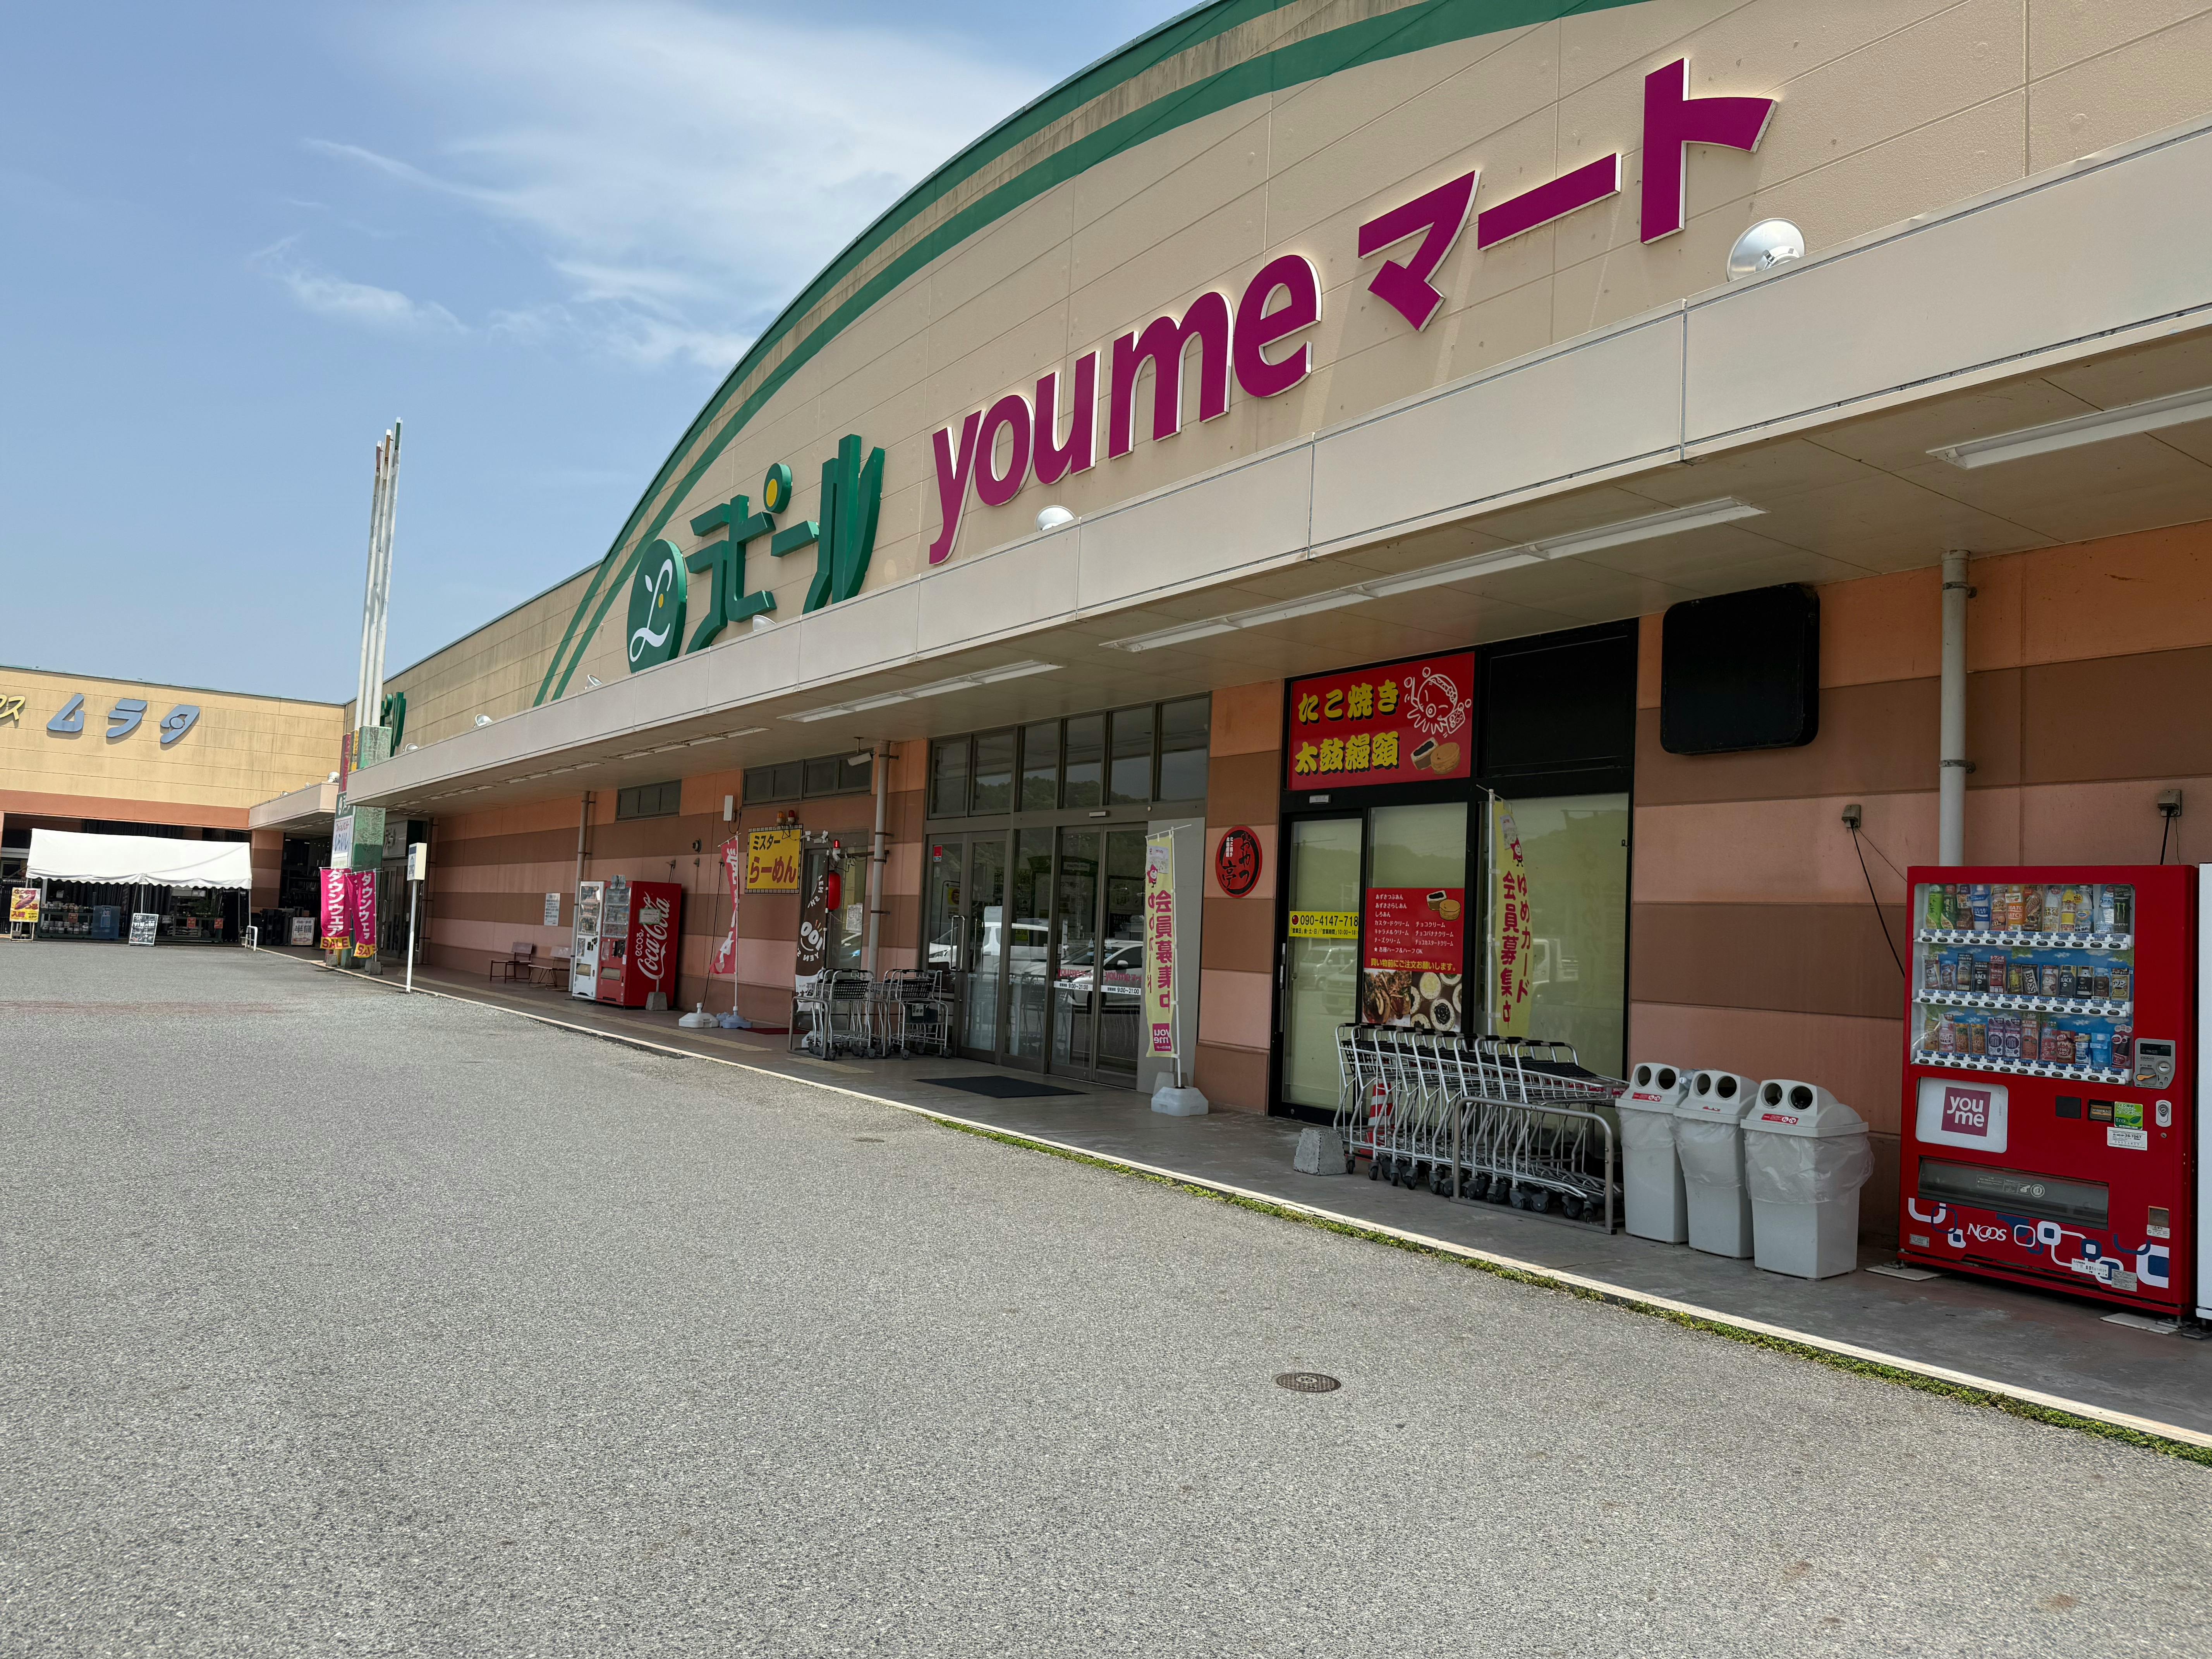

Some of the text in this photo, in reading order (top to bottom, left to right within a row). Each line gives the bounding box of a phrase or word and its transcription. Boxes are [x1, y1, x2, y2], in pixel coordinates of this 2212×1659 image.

[929, 57, 1778, 565] youme マート
[685, 434, 885, 654] ラピール
[1298, 679, 1400, 723] たこ焼き
[47, 693, 200, 743] ムラタ
[1295, 732, 1399, 774] 太鼓饅頭
[753, 834, 780, 850] ミスター
[749, 855, 797, 883] らーめん
[323, 938, 348, 948] SALE
[1500, 871, 1519, 1029] 会員募集中
[1516, 873, 1531, 1003] ゆめカード
[1371, 958, 1456, 971] 買い物前にご注文お願いします。
[2025, 972, 2037, 993] BOSS
[1947, 1096, 1984, 1114] you
[1954, 1111, 1985, 1127] me
[1967, 1223, 2007, 1242] NOOS
